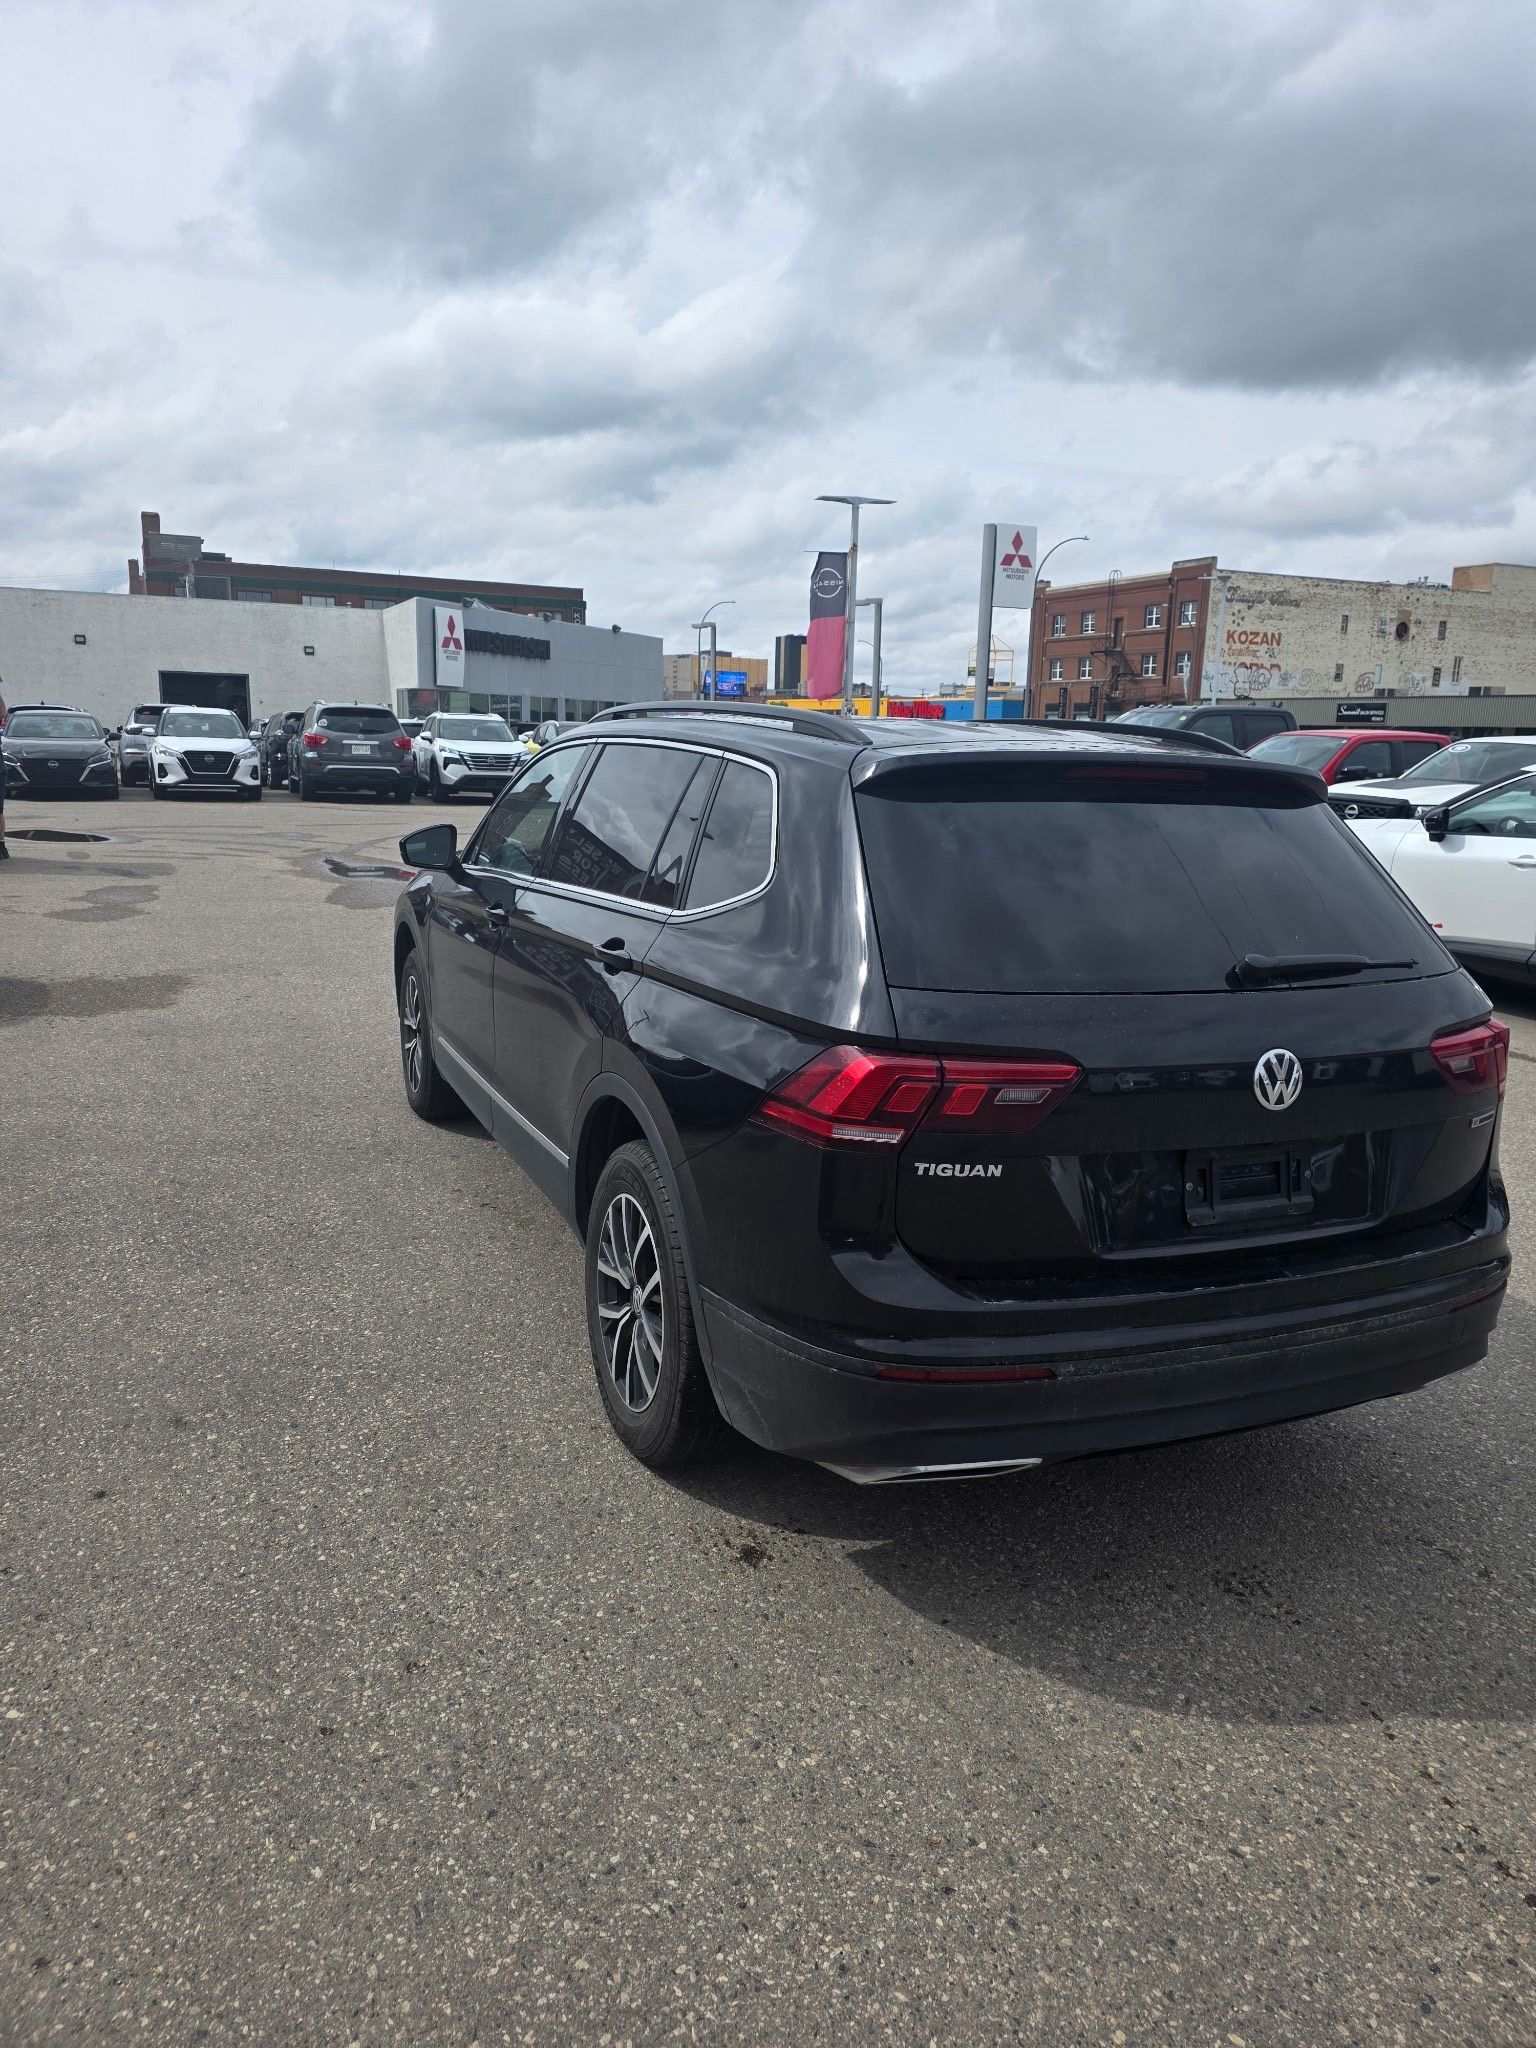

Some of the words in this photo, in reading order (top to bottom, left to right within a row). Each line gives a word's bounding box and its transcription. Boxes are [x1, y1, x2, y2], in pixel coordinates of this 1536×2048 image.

[1002, 566, 1029, 574] MITSUBISHI
[464, 628, 550, 660] MITSUBISHI
[1226, 630, 1281, 646] KOZAN
[889, 701, 912, 718] Value
[912, 701, 944, 719] Village
[914, 1162, 1003, 1177] TIGUAN
